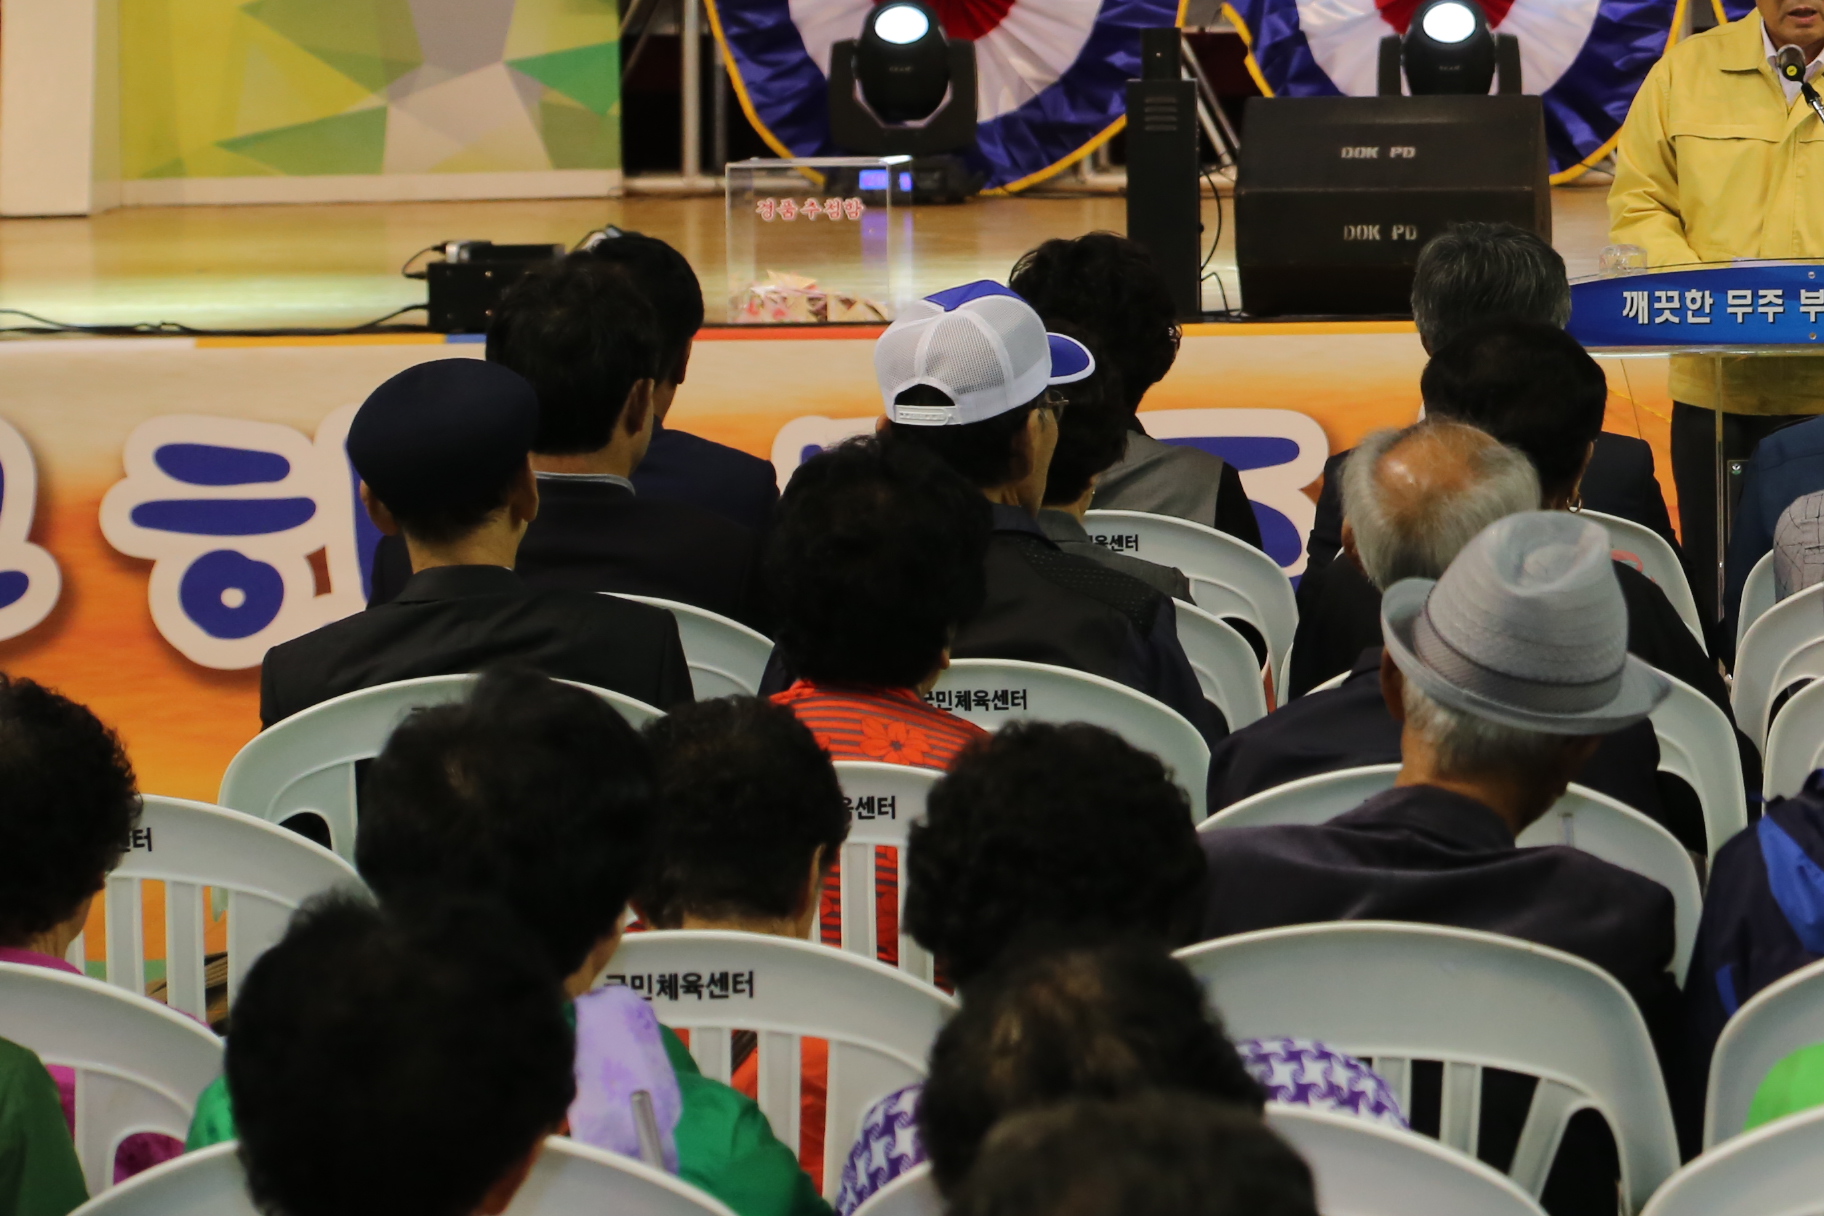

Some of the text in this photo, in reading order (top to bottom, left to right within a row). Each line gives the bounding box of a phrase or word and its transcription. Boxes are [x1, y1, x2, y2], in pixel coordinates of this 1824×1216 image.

[1341, 146, 1416, 159] DOK PD
[1343, 224, 1417, 241] DOK PD
[1621, 288, 1713, 325] 깨끗한
[1726, 289, 1785, 325] 무주
